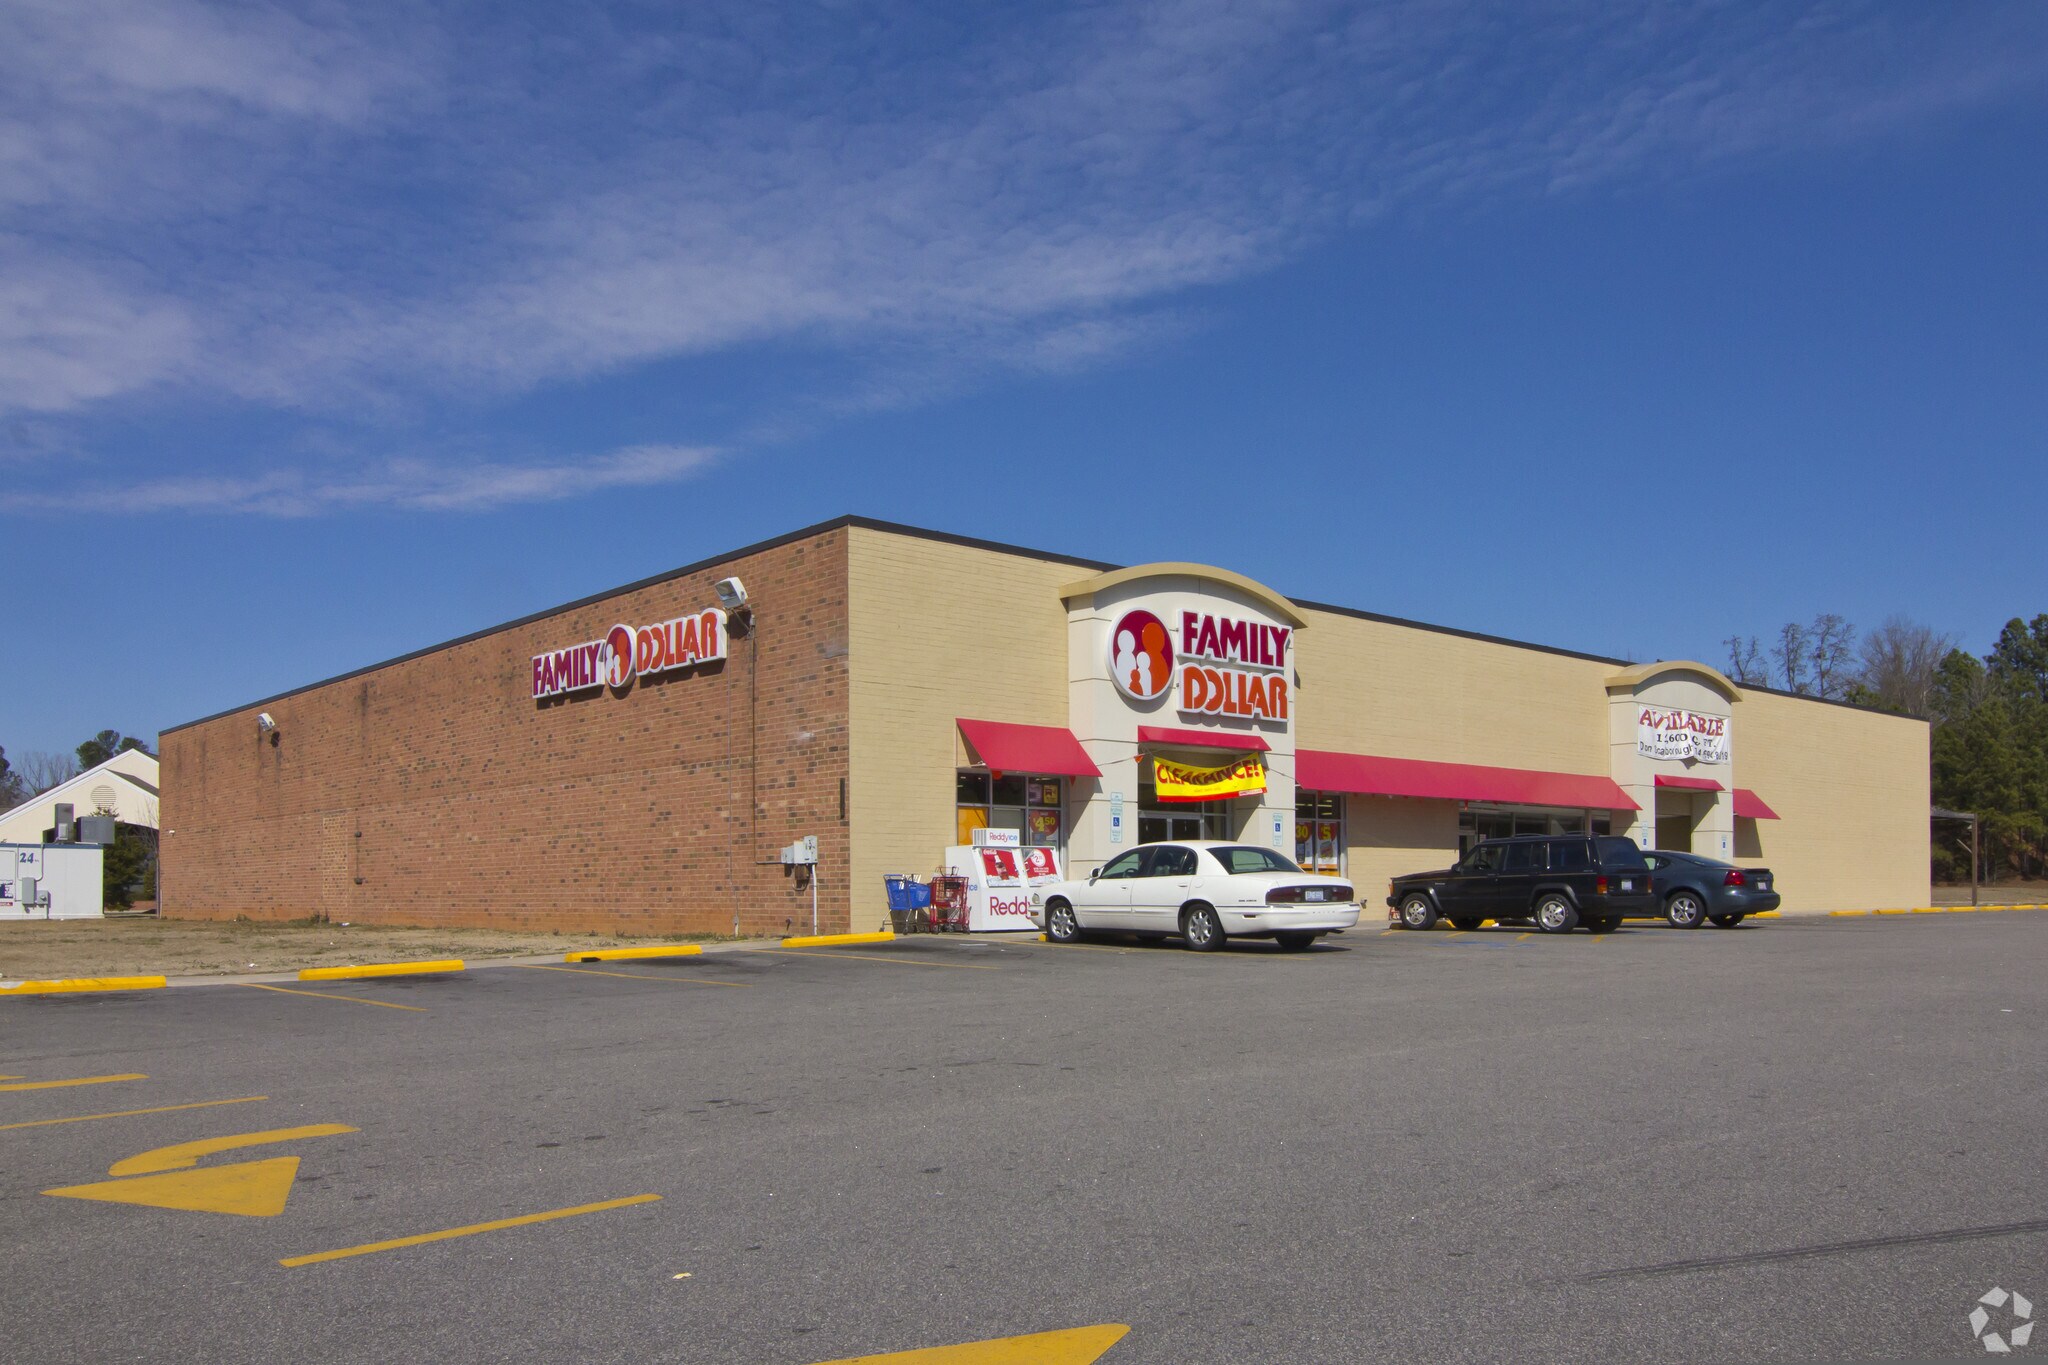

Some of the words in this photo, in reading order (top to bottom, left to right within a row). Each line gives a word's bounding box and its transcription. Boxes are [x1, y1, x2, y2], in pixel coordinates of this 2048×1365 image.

[533, 642, 602, 696] FAMILY
[636, 611, 718, 673] DOLLAR
[1183, 611, 1291, 667] FAMILY
[1184, 666, 1288, 719] DOLLAR
[1156, 758, 1260, 785] CLEARANCE!
[20, 852, 34, 863] 24
